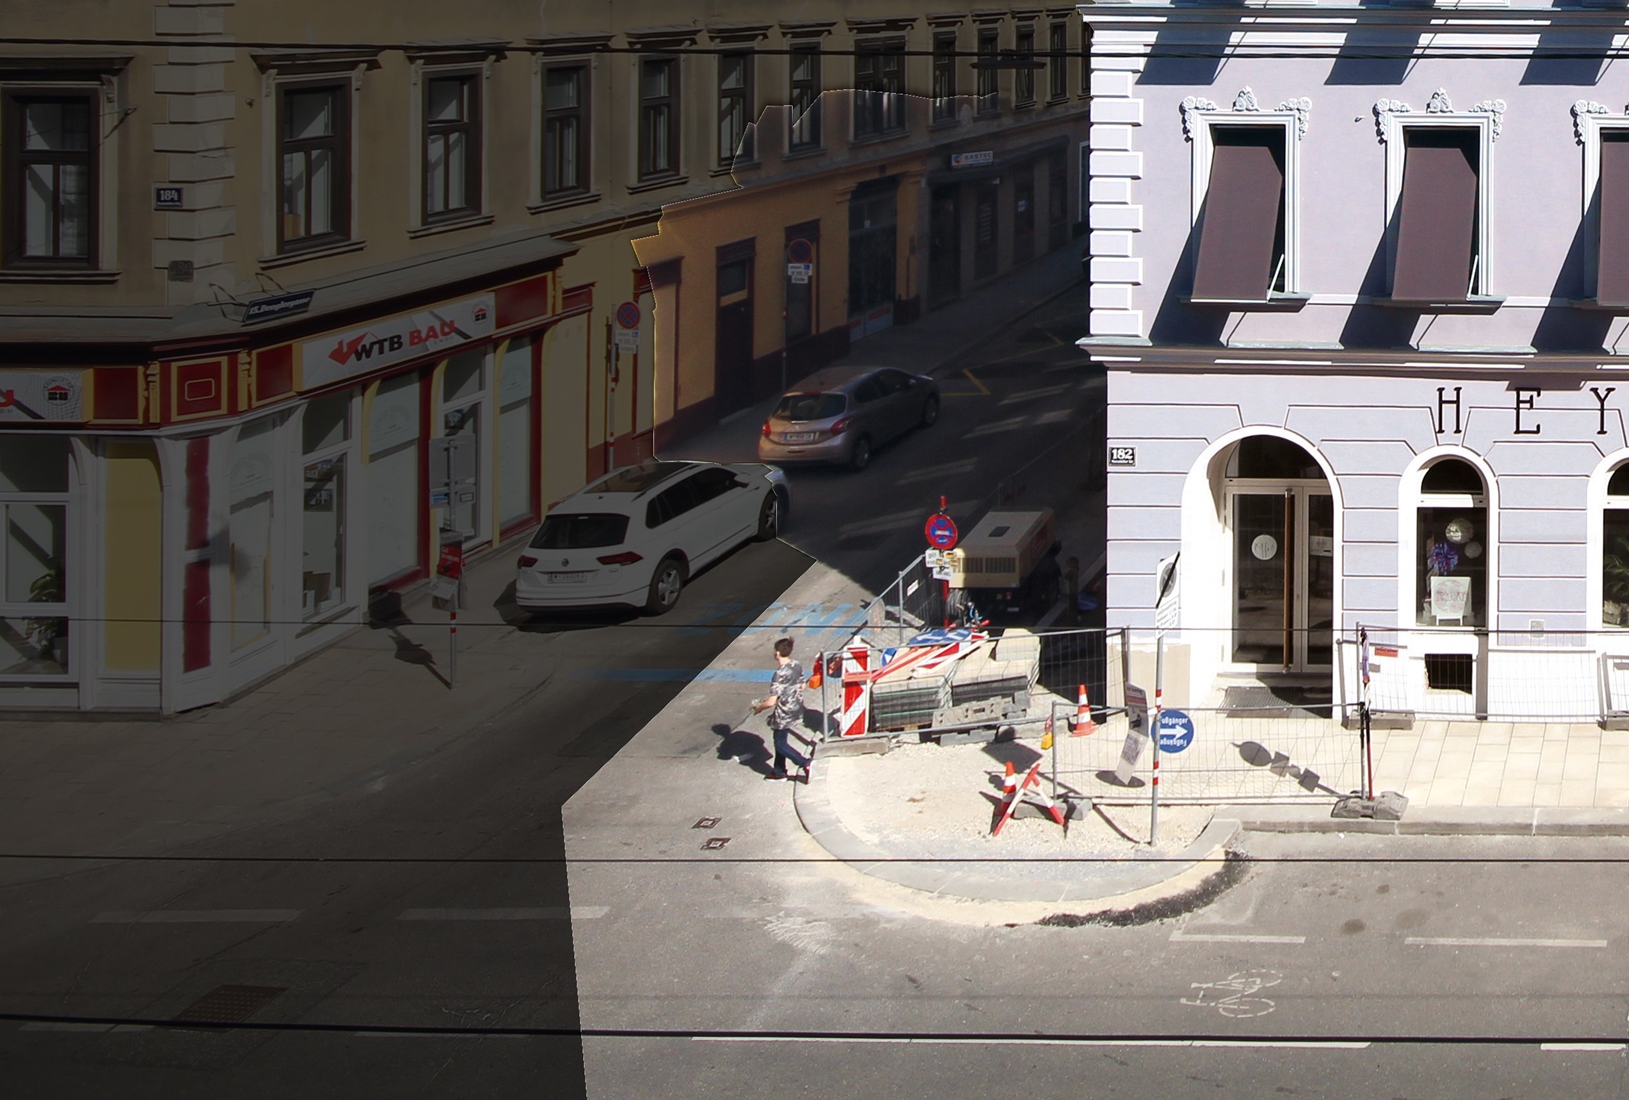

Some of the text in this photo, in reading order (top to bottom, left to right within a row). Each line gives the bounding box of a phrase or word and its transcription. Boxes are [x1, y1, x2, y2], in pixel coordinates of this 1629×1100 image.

[159, 190, 178, 201] 184
[353, 320, 456, 361] WTB BAU
[1111, 448, 1133, 460] 182
[1161, 716, 1188, 725] ußgänger
[1160, 738, 1187, 747] Fußgänge
